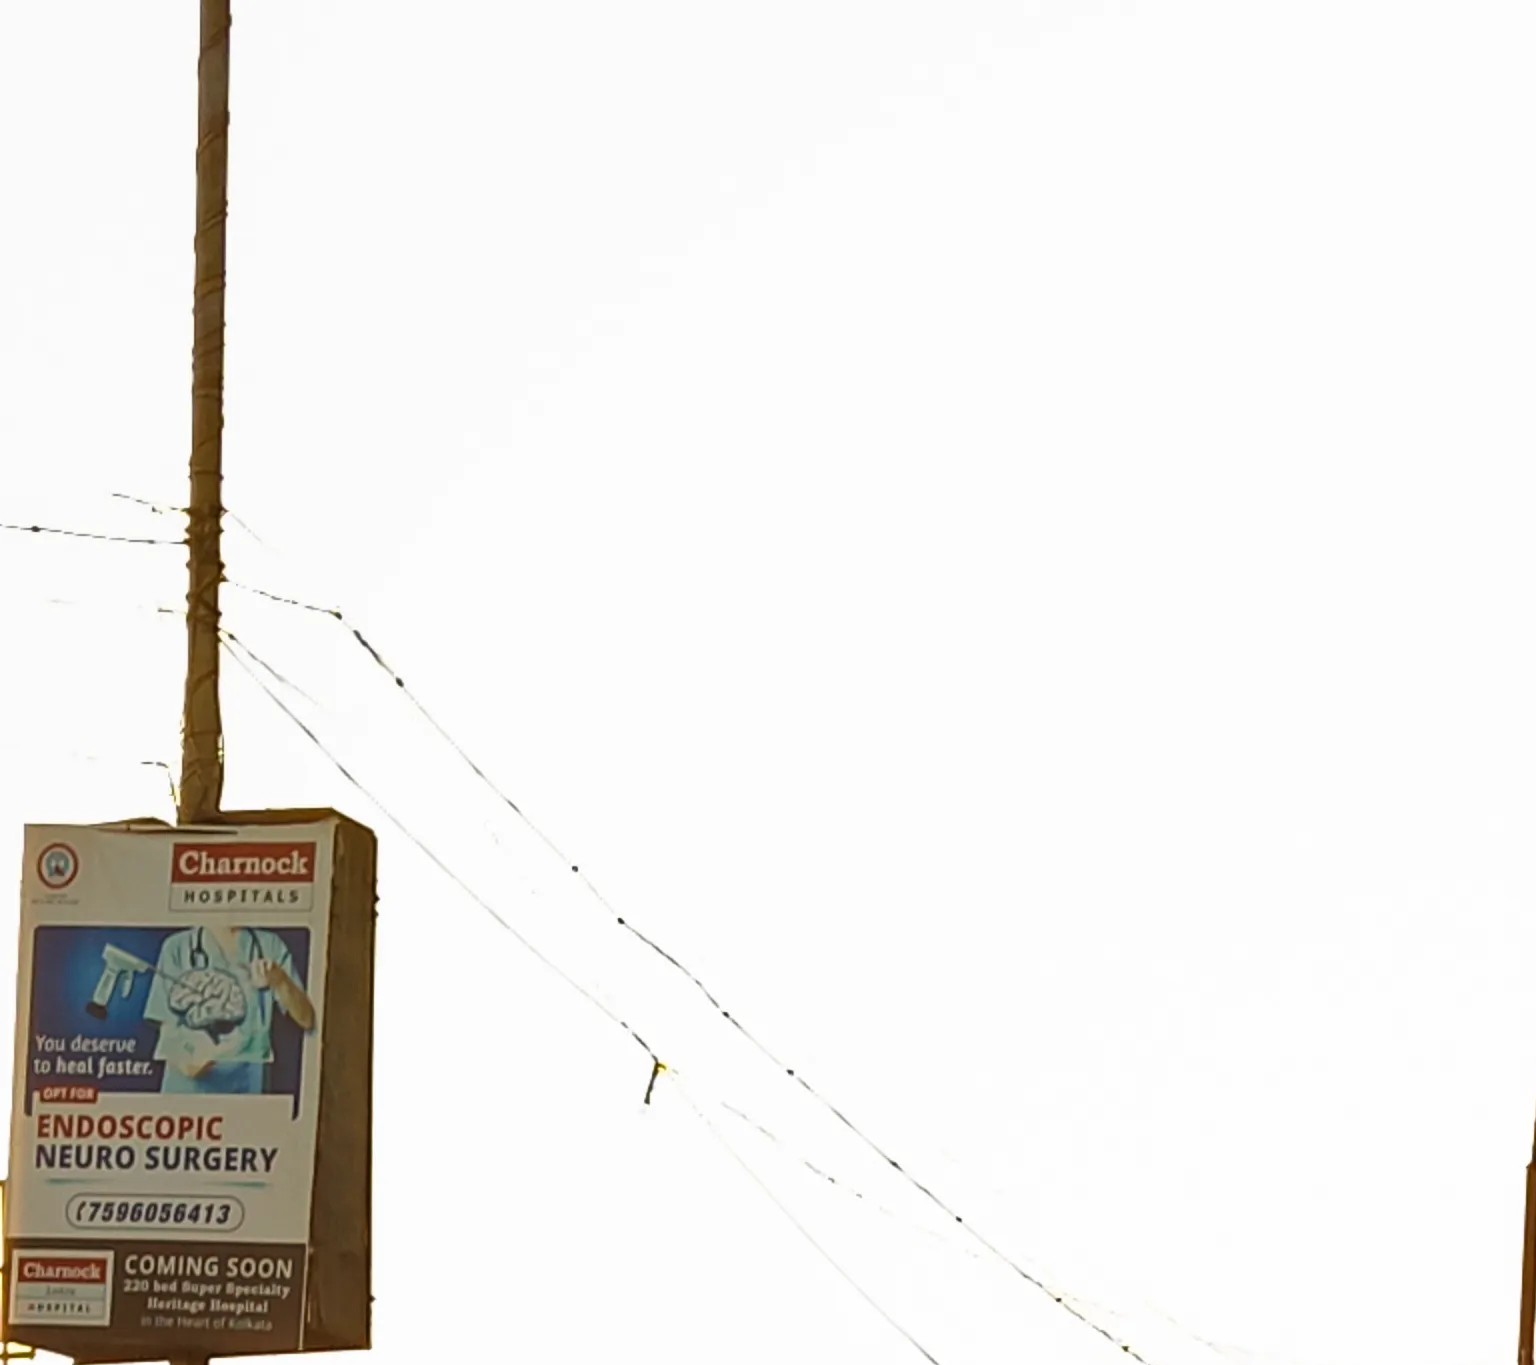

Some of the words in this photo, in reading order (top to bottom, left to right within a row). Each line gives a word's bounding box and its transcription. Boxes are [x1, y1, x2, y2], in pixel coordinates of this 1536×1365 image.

[178, 849, 309, 876] Charnock
[183, 888, 300, 904] HOSPITALS
[34, 1034, 66, 1053] You
[71, 1034, 137, 1053] deserve
[33, 1058, 51, 1075] to
[55, 1056, 93, 1076] heal
[97, 1057, 153, 1079] faster.
[42, 1087, 68, 1100] OPT
[69, 1088, 95, 1101] FOR
[36, 1114, 225, 1141] ENDOSCOPIC
[35, 1143, 136, 1170] NEURO
[144, 1146, 279, 1173] SURGERY
[22, 1261, 101, 1279] Charnock
[123, 1254, 220, 1279] COMING
[225, 1257, 294, 1280] SOON
[152, 1279, 178, 1294] bed
[180, 1280, 223, 1297] Super
[209, 1299, 269, 1316] Hospital
[154, 1315, 174, 1328] the
[212, 1317, 226, 1330] of
